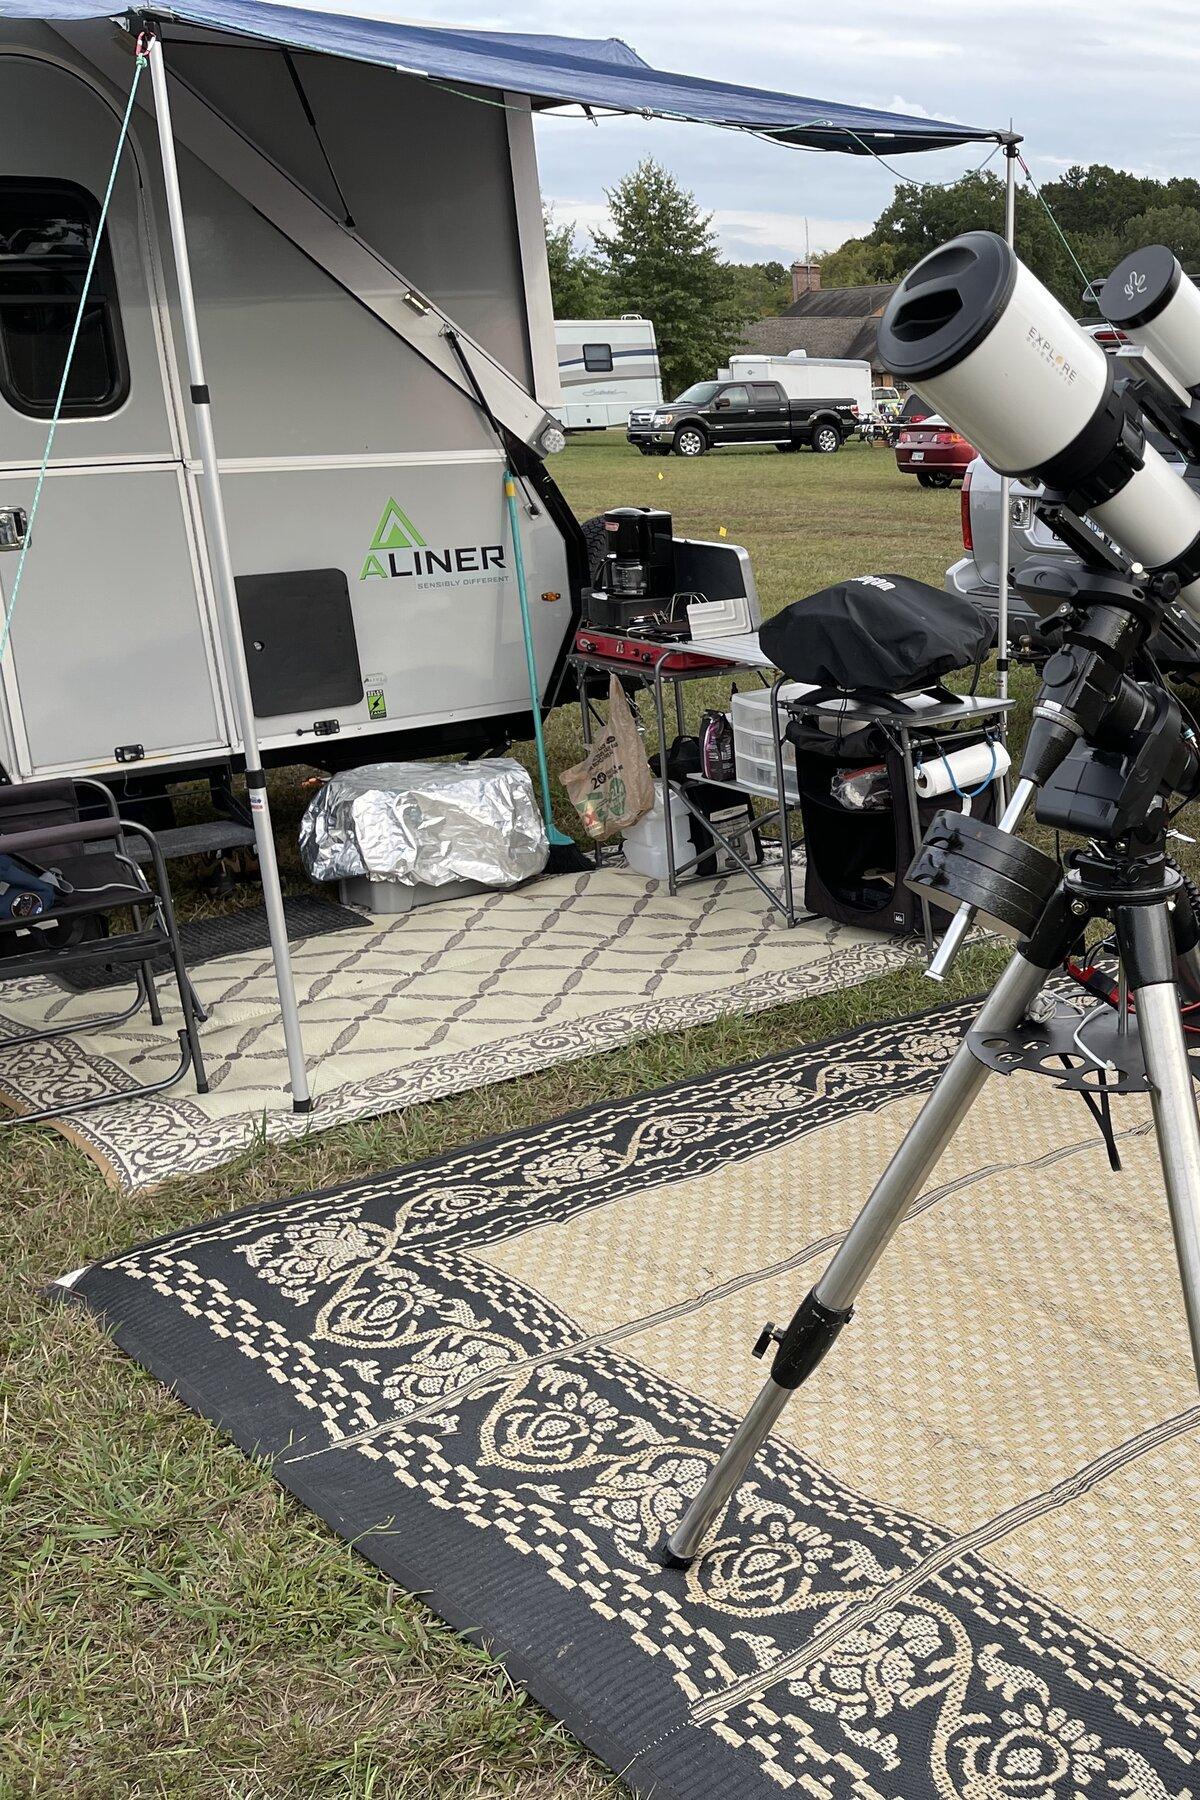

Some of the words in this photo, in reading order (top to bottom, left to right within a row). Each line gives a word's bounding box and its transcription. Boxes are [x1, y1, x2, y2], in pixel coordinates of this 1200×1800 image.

[1028, 326, 1078, 382] EXPLORE
[359, 545, 507, 581] ALINER
[417, 580, 460, 590] SENSIBLY
[463, 575, 510, 586] DIFFERENT
